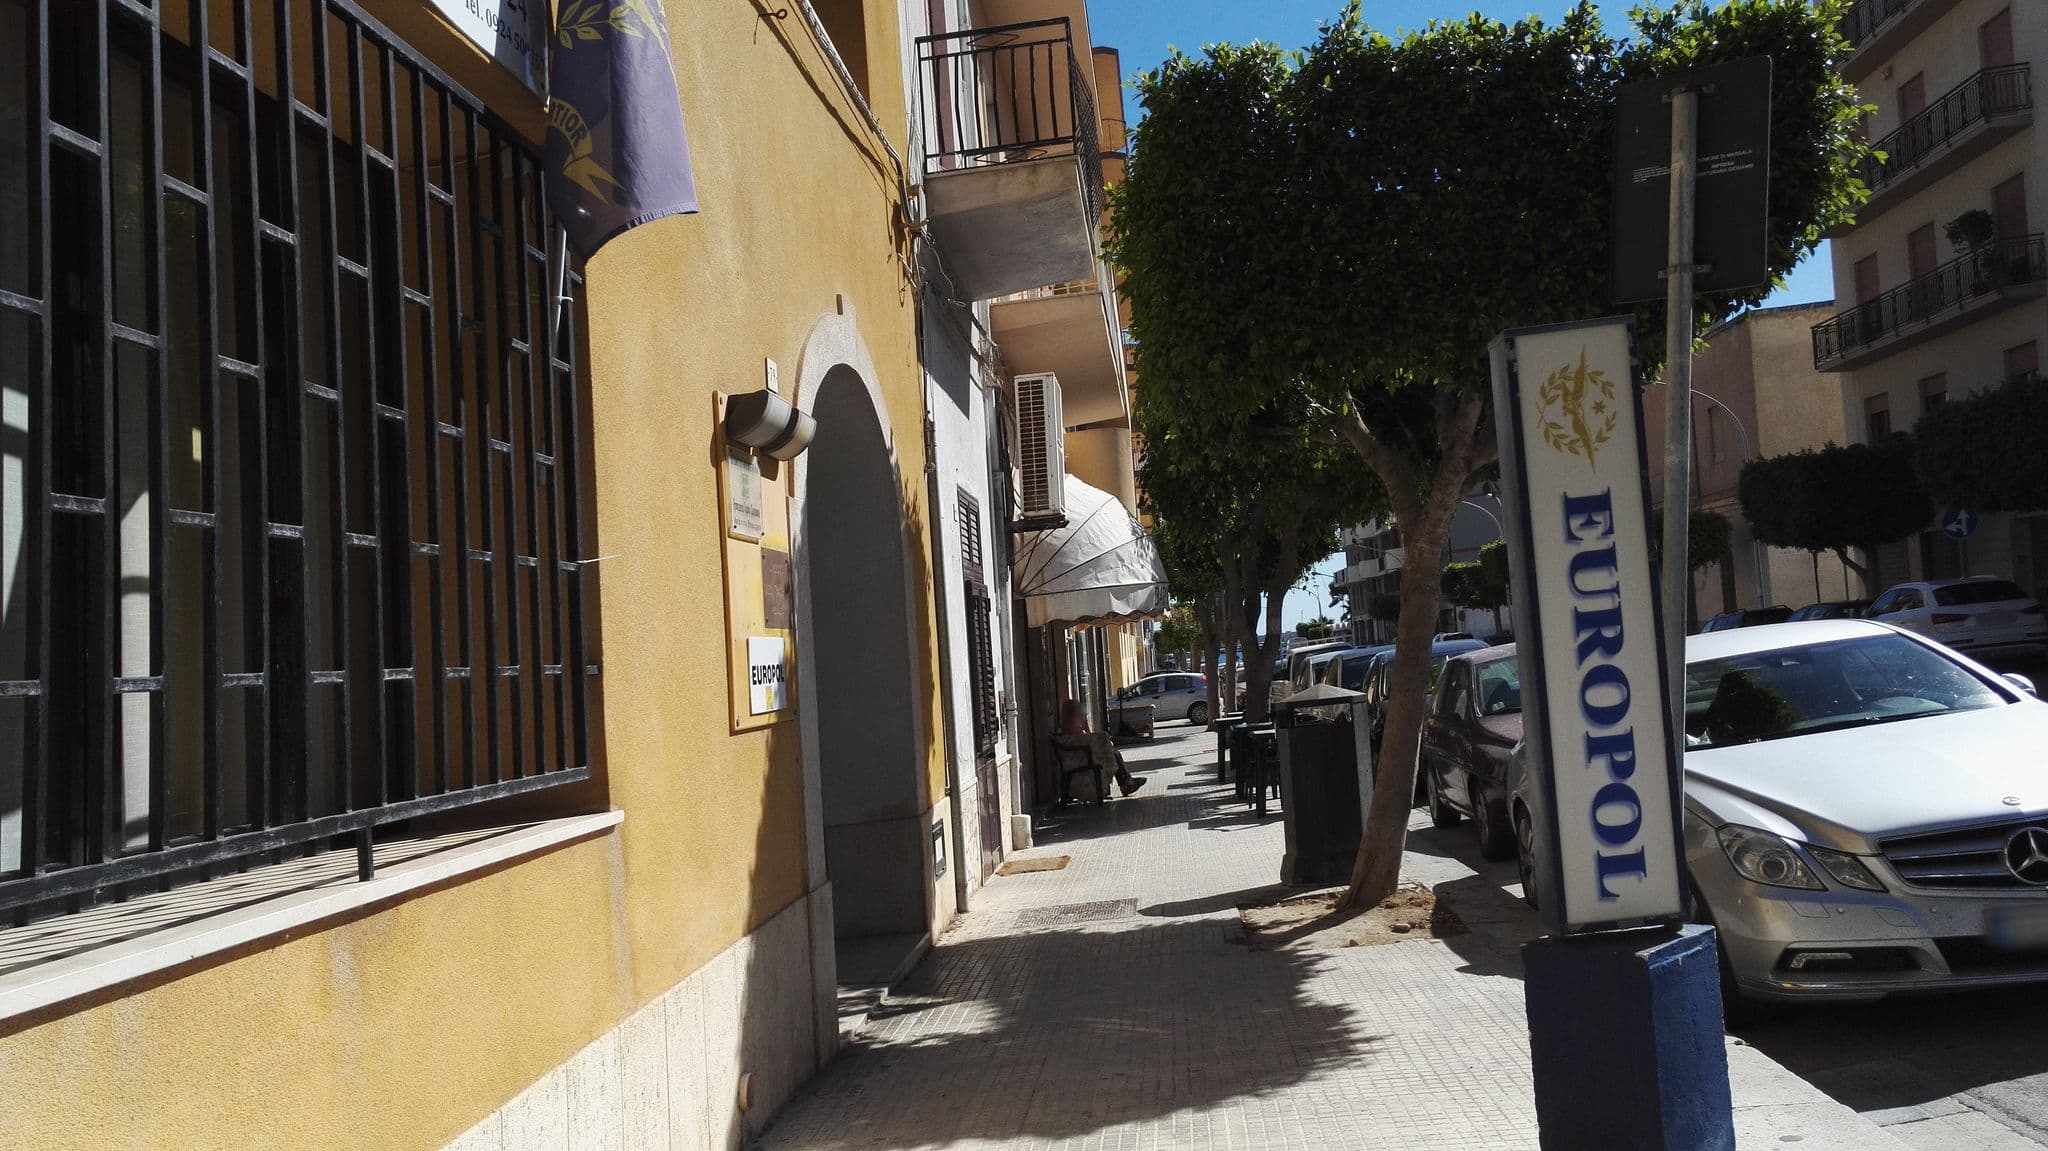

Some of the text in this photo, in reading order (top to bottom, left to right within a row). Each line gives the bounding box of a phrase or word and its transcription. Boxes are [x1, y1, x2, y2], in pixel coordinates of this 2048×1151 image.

[485, 8, 512, 45] 0924
[752, 663, 785, 686] EUROPOL
[1561, 486, 1648, 900] EUROPOL
